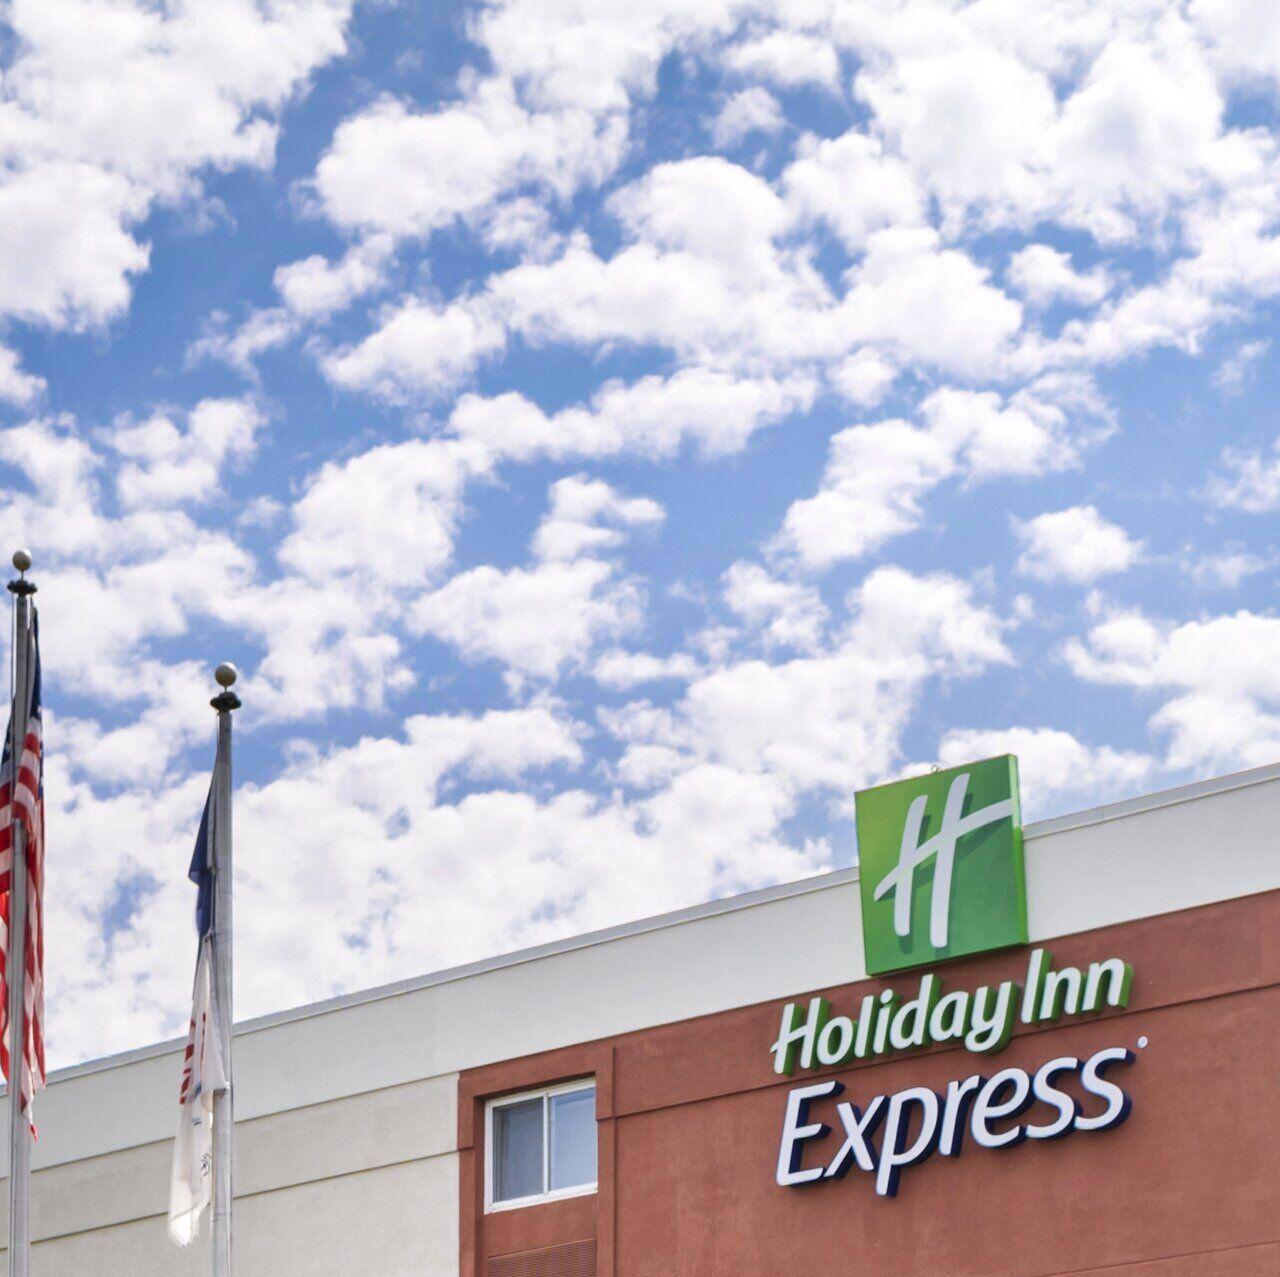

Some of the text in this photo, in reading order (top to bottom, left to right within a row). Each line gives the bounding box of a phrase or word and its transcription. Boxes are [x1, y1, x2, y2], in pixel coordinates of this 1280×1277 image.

[873, 772, 1013, 948] H
[771, 948, 1131, 1075] Holiday Inn
[775, 1047, 1134, 1197] Express
